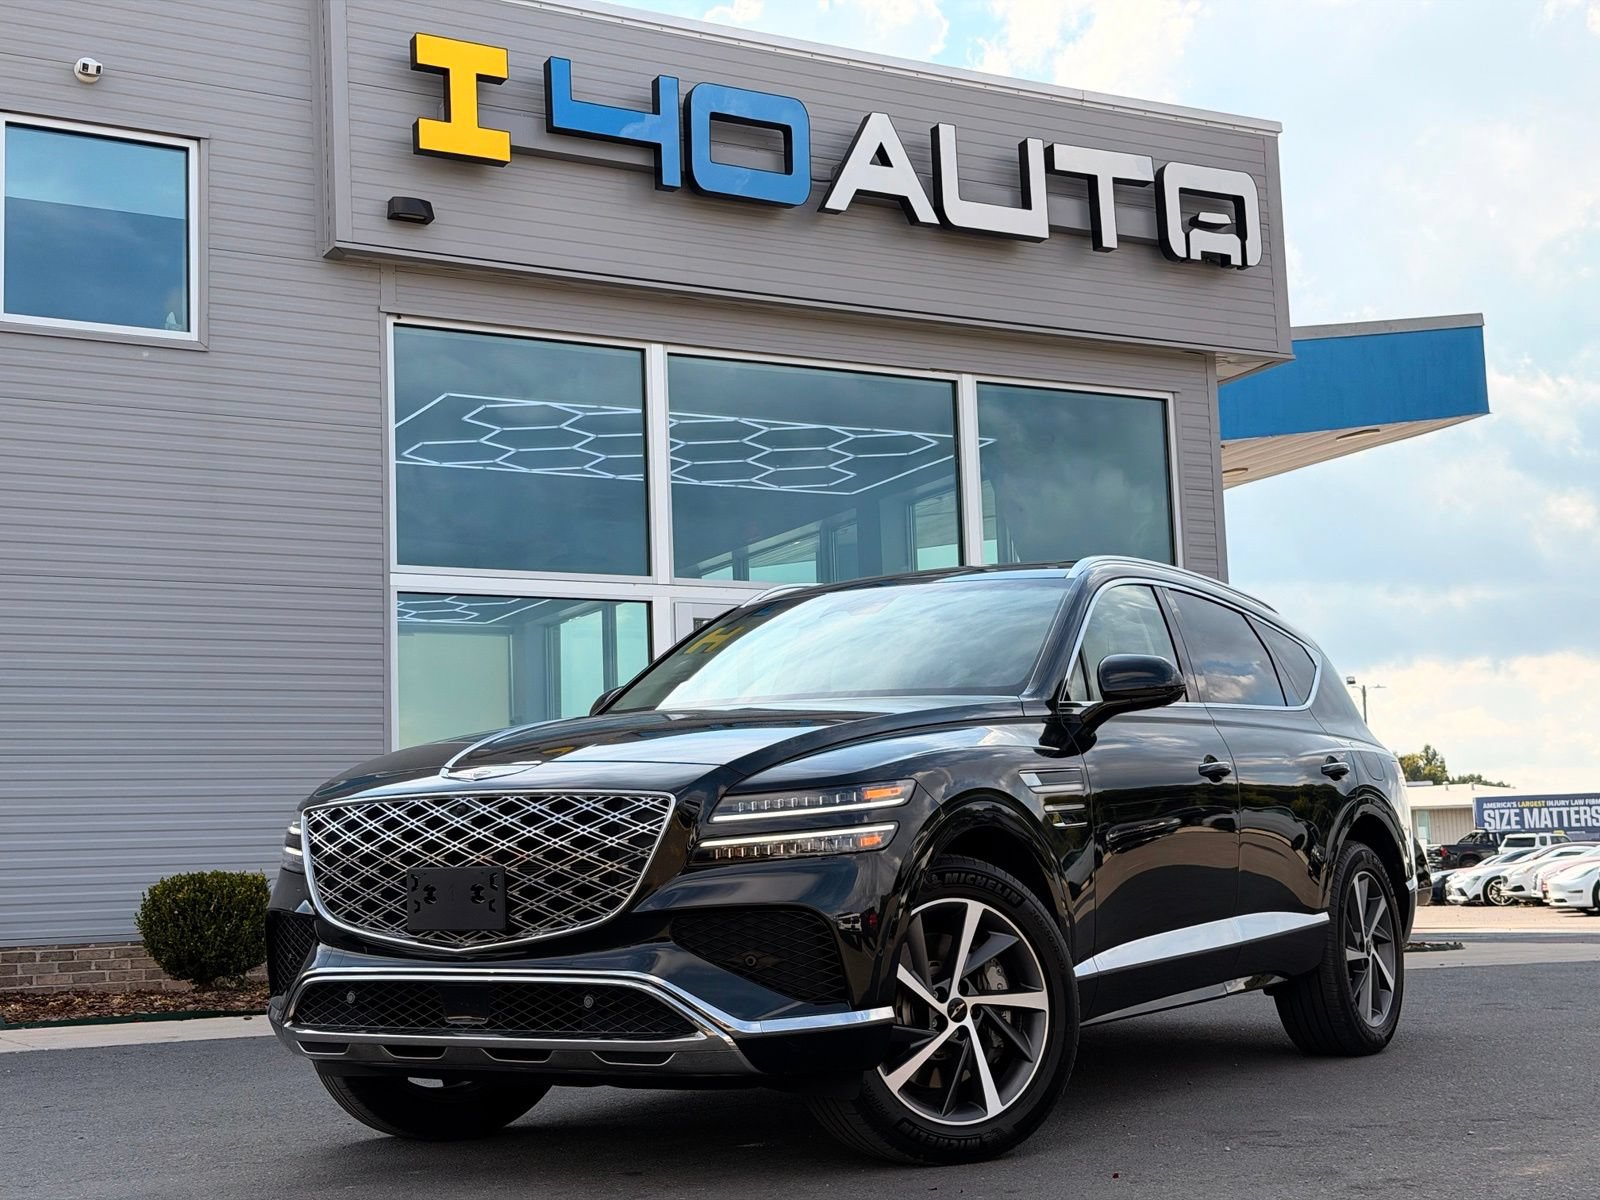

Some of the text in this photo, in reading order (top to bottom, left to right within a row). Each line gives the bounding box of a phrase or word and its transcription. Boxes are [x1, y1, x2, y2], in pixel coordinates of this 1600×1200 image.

[1482, 801, 1517, 809] AMERICA'S
[1518, 800, 1546, 808] LARGEST
[1546, 799, 1569, 807] INJURY
[1570, 798, 1585, 806] LAW
[1483, 806, 1600, 830] SIZE MATTERS
[944, 871, 1023, 906] MICHELIN
[863, 1079, 890, 1116] PRIMAC
[898, 1120, 981, 1153] MICHELIN
